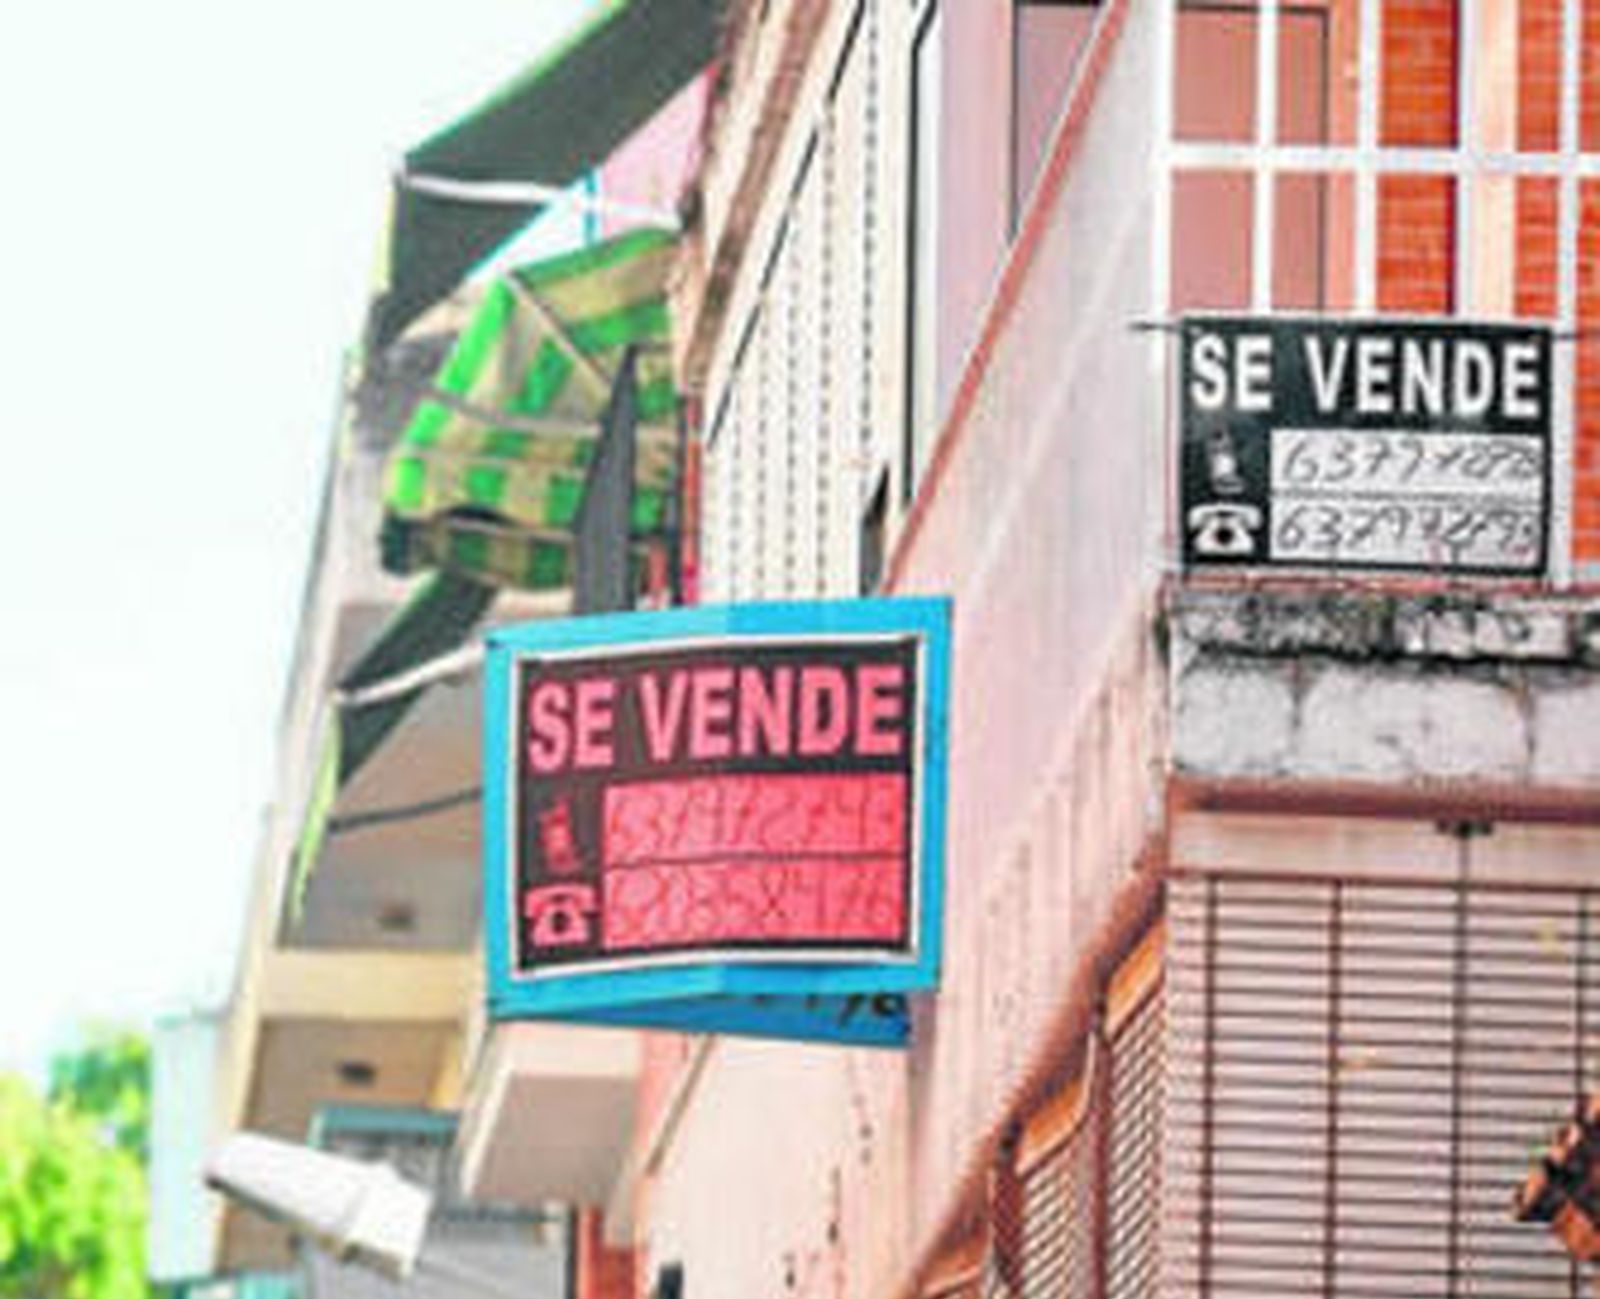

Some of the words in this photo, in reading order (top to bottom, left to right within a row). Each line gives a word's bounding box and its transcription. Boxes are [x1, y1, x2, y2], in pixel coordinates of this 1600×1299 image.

[1189, 332, 1273, 412] SE
[1304, 335, 1542, 418] VENDE
[527, 678, 616, 774] SE
[639, 662, 906, 762] VENDE
